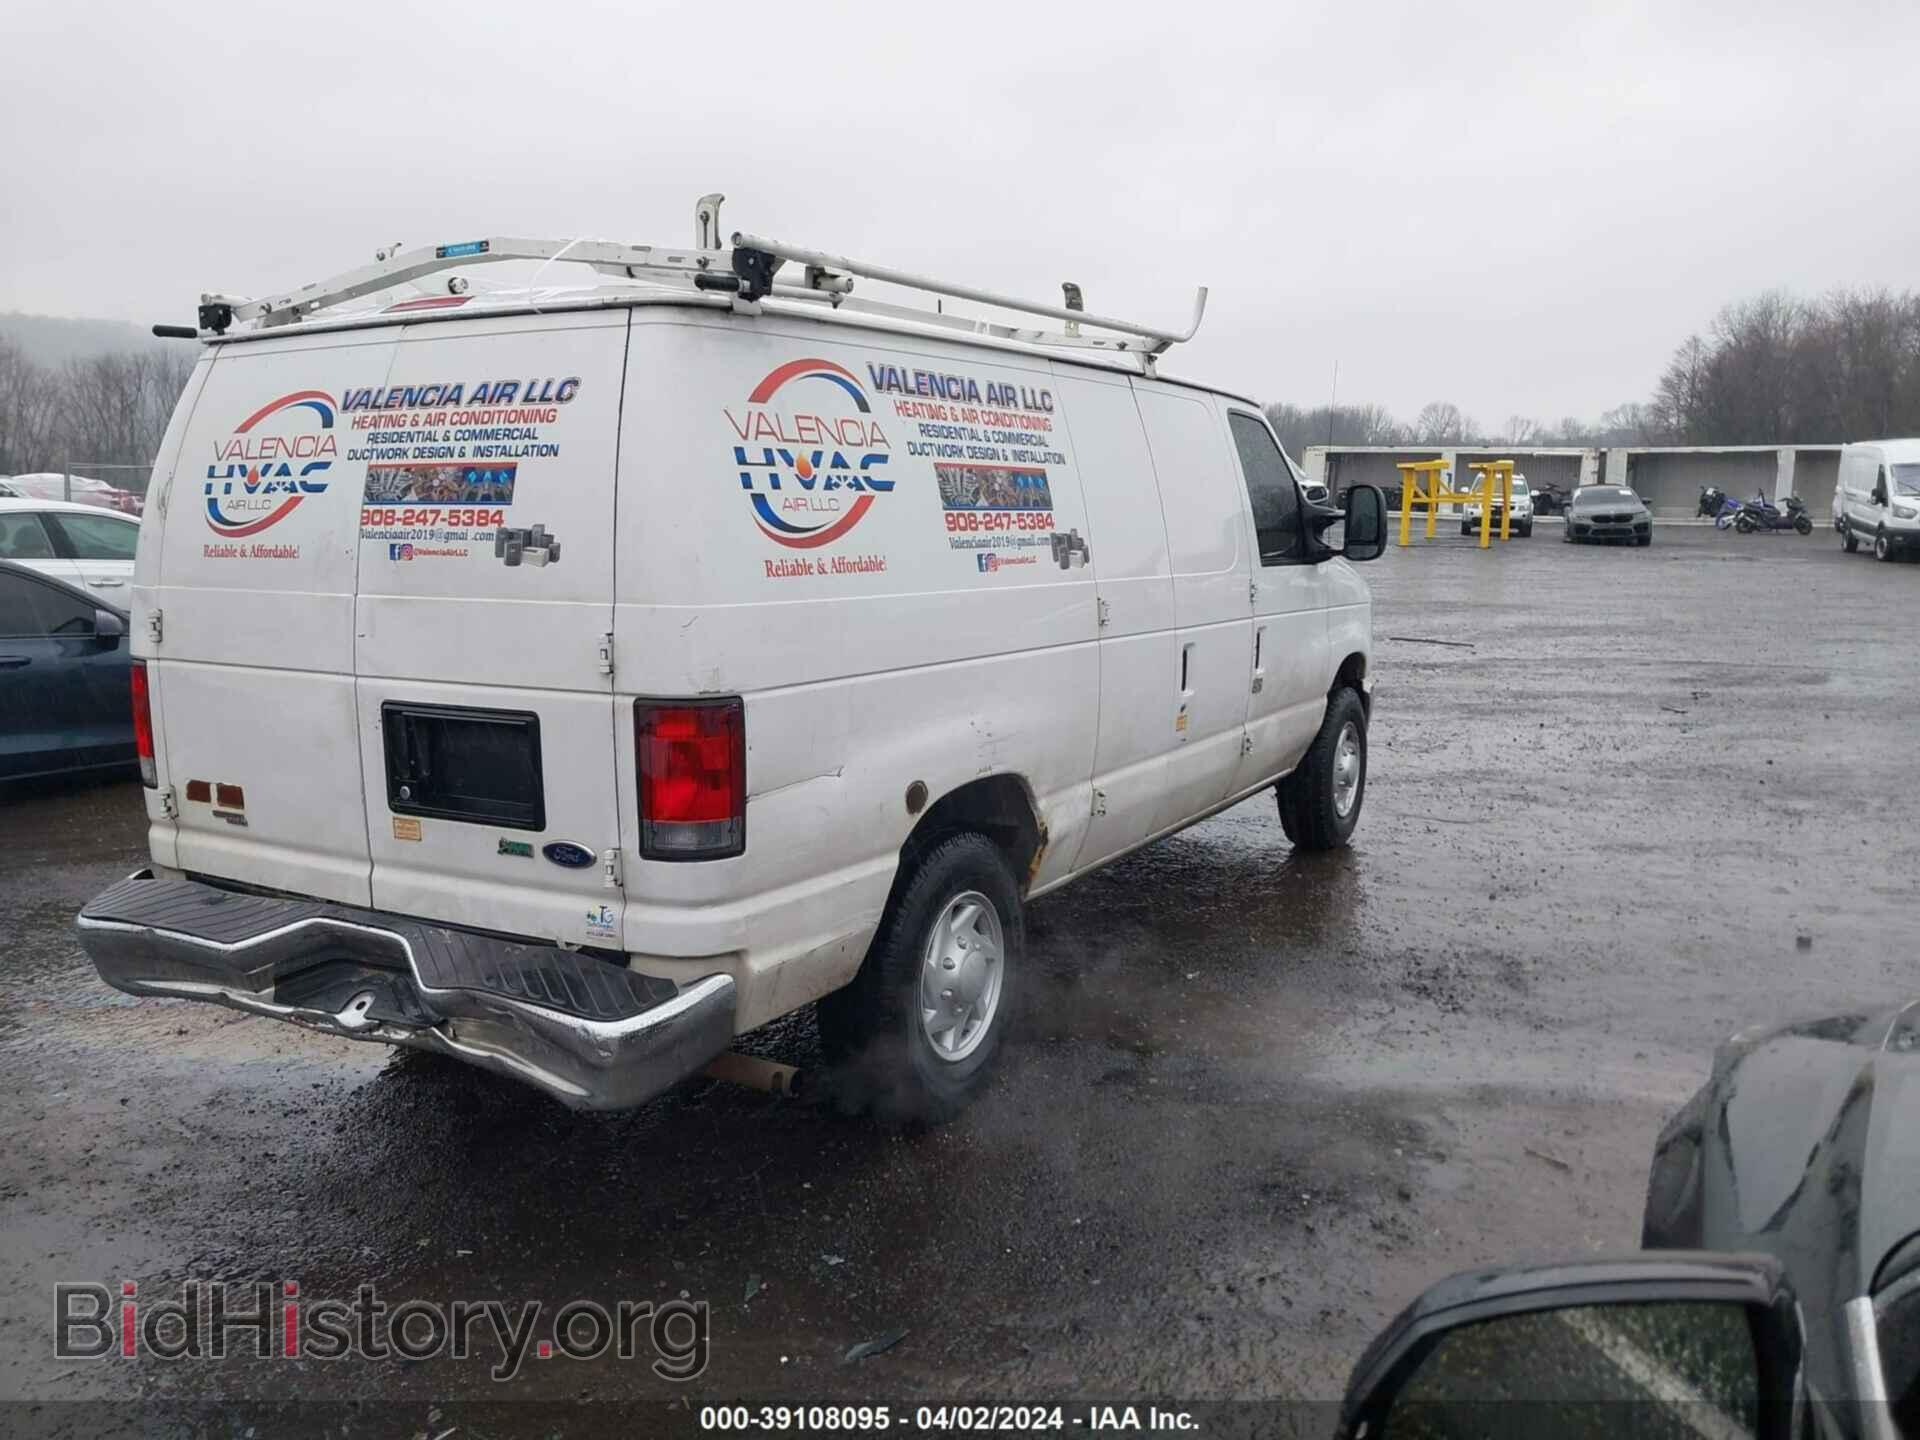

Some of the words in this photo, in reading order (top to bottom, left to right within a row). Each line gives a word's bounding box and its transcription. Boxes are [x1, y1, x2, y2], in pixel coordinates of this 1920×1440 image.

[340, 384, 464, 413] VALENCIA
[466, 381, 521, 406] AIR
[522, 377, 582, 404] LLC
[866, 361, 985, 404] VALENCIA
[985, 380, 1018, 408] AIR
[1019, 386, 1054, 414] LLC
[351, 413, 407, 430] HEATING
[410, 412, 419, 427] &
[423, 411, 446, 428] AIR
[449, 408, 557, 426] CONDITIONING
[894, 400, 947, 421] HEATING
[950, 407, 959, 422] &
[962, 408, 979, 423] AIR
[980, 410, 1052, 432] CONDITIONING
[367, 430, 439, 445] RESIDENTIAL
[442, 430, 450, 442] &
[454, 427, 538, 442] COMMERCIAL
[724, 408, 891, 449] VALENCIA
[918, 423, 982, 442] RESIDENTIAL
[984, 430, 991, 442] &
[992, 430, 1049, 448] COMMERCIAL
[213, 434, 337, 461] VALENCIA
[347, 447, 409, 461] DUCTWORK
[412, 445, 455, 460] DESIGN
[458, 445, 466, 458] &
[472, 443, 560, 458] INSTALLATION
[907, 441, 965, 459] DUCTWORK
[967, 445, 1000, 462] DESIGN
[1002, 449, 1008, 462] &
[1012, 449, 1066, 465] INSTALLATION
[204, 461, 332, 495] HVAC
[734, 446, 896, 492] HVAC
[225, 499, 246, 511] AIR
[247, 499, 272, 511] LLC
[782, 496, 809, 512] AIR
[811, 498, 840, 512] LLC
[944, 512, 1055, 532] 908-247-5384
[203, 543, 238, 558] Reliable
[239, 544, 247, 558] &
[249, 543, 300, 559] Affordable!
[764, 558, 813, 578] Reliable
[816, 557, 827, 575] &
[830, 555, 887, 574] Affordable!
